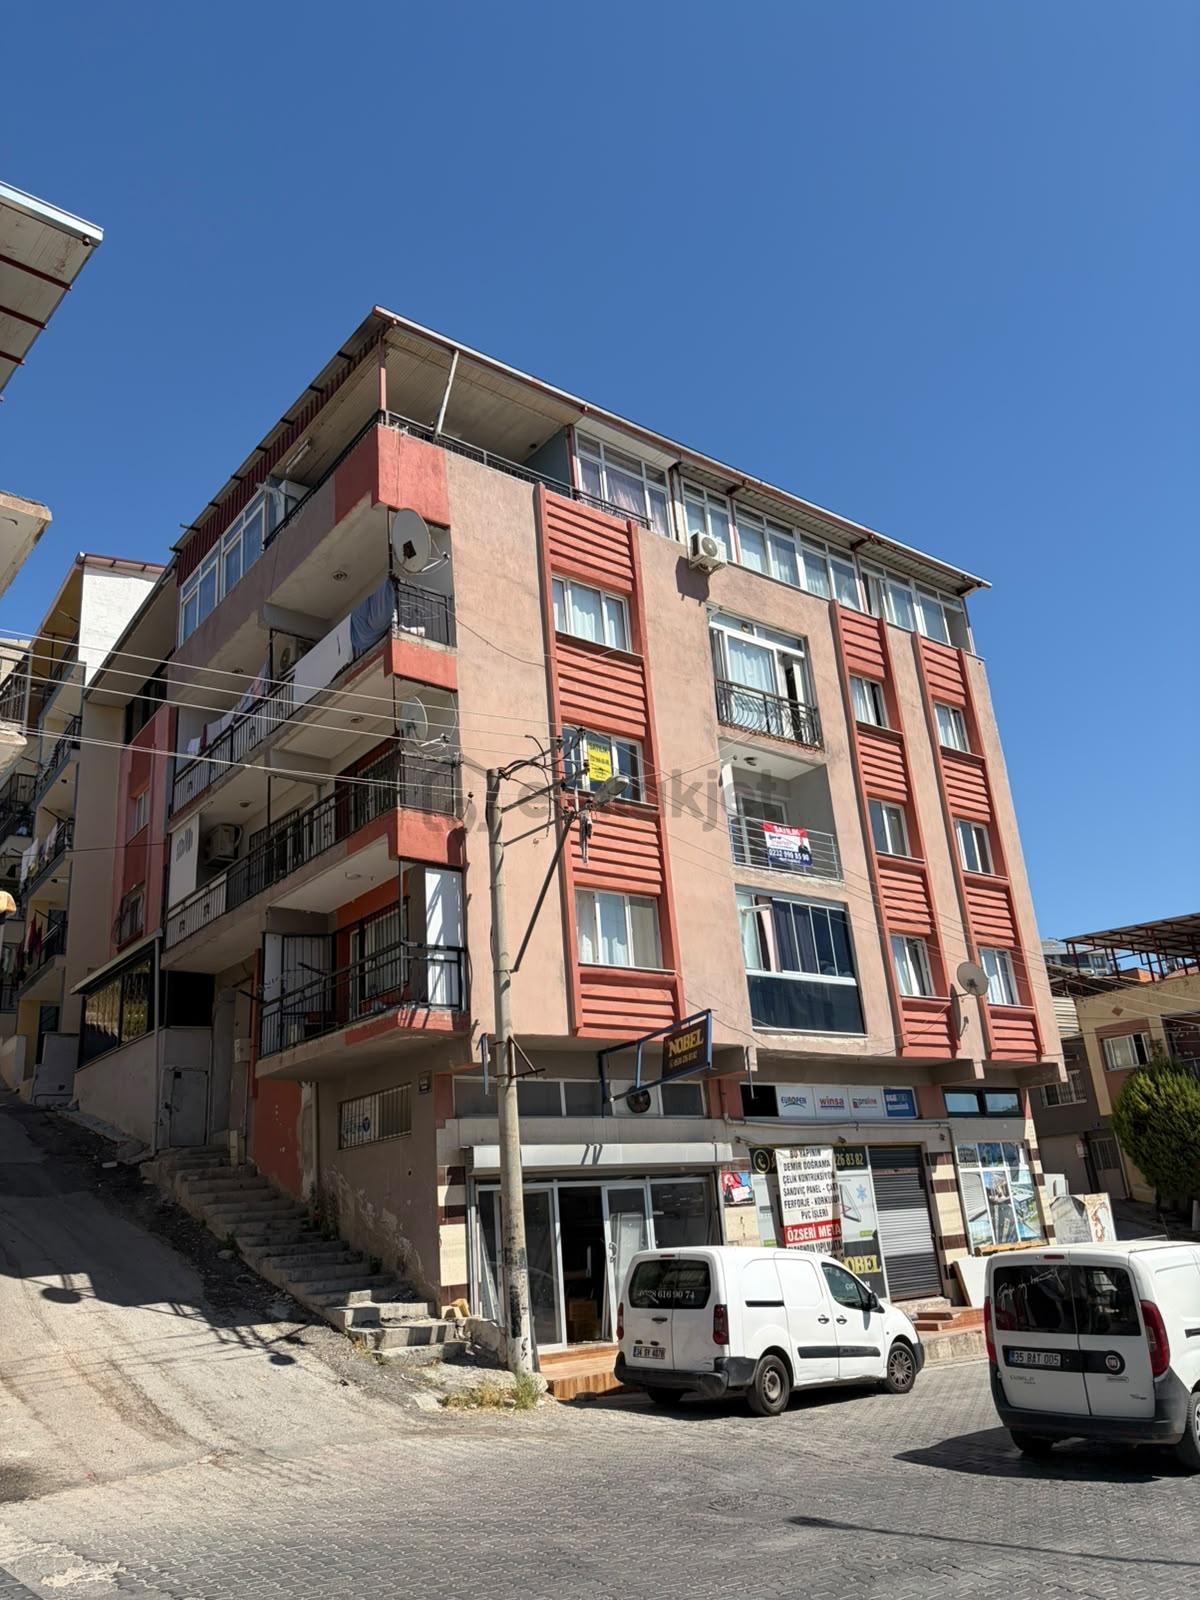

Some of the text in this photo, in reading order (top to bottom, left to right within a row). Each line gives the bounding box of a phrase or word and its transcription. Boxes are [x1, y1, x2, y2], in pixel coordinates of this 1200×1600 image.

[668, 1029, 704, 1058] NOBEL
[820, 1096, 844, 1106] winsa
[806, 1184, 821, 1195] PANEL
[800, 1210, 811, 1220] PVC
[787, 1223, 817, 1242] ÖZSERİ
[1015, 1351, 1059, 1366] 35 BAT 005
